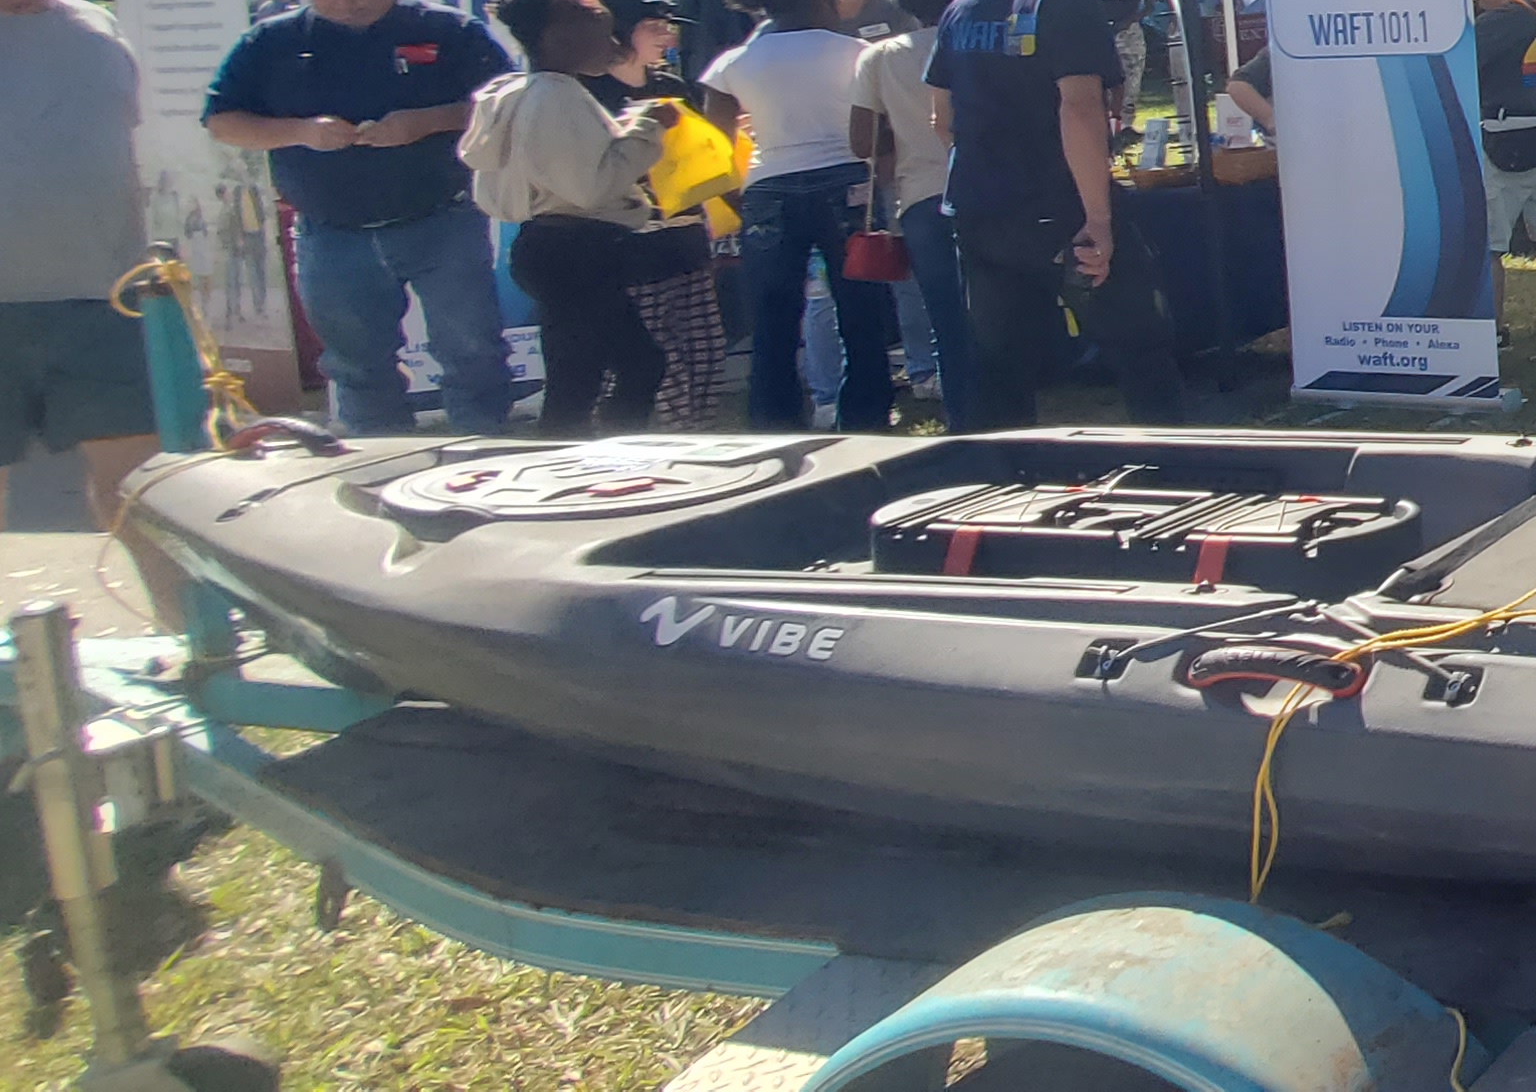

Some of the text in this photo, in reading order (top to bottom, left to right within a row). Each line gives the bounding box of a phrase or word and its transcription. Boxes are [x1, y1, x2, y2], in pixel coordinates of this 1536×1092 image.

[1307, 9, 1429, 47] WAFT 101.1
[1342, 321, 1440, 334] LISTEN ON YOUR
[1325, 336, 1460, 350] Radio Phone Alexa
[1357, 351, 1429, 371] waft.org
[719, 615, 845, 661] VIBE
